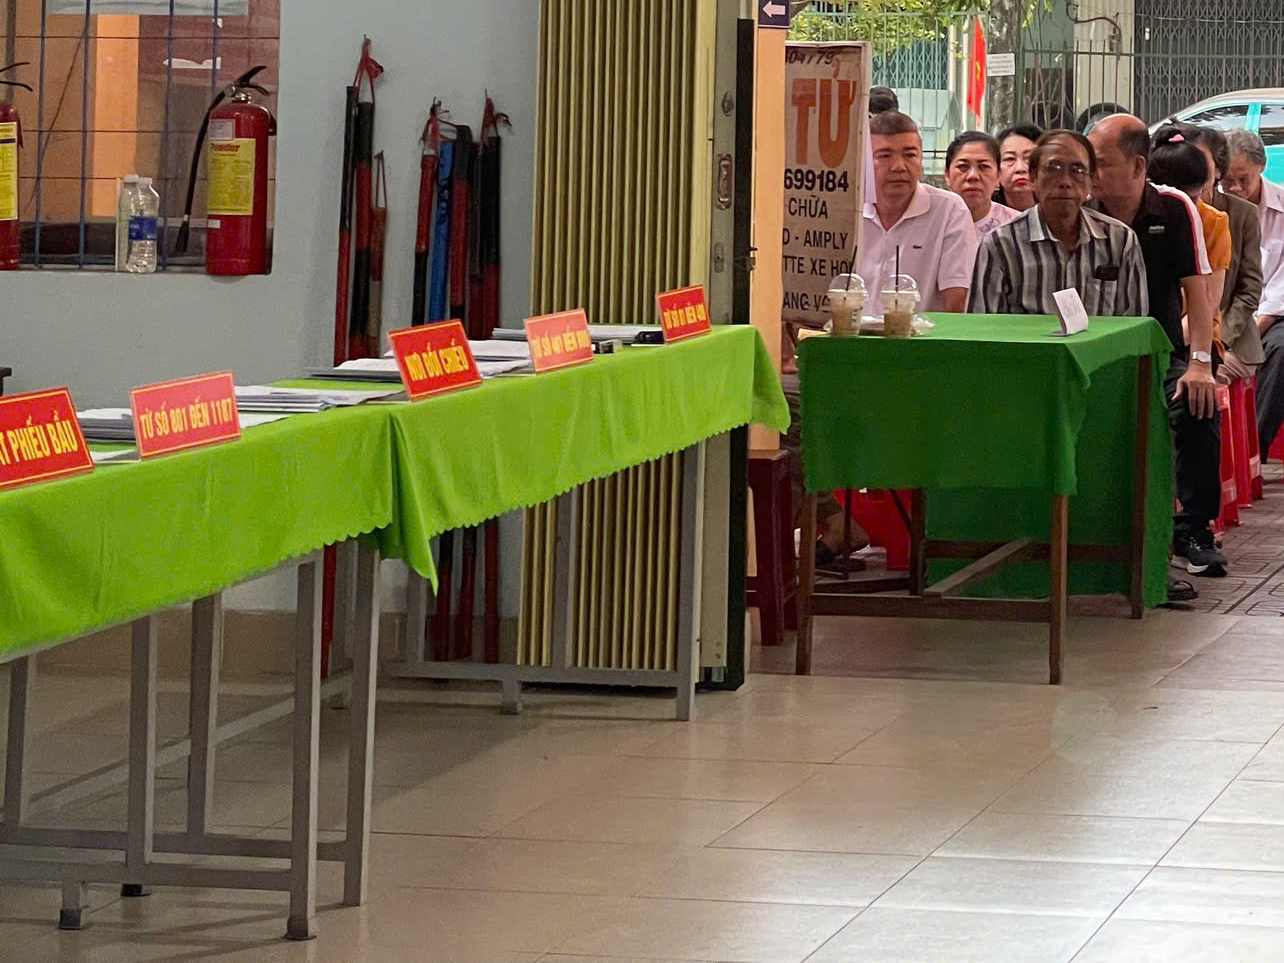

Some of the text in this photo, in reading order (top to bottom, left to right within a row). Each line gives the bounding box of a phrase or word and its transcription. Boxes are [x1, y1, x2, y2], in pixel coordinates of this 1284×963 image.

[784, 168, 849, 192] 699184
[788, 194, 828, 219] CHỮA
[803, 229, 848, 250] AMPLY
[810, 257, 827, 276] XE
[140, 408, 154, 439] TỪ
[155, 401, 170, 436] SỐ
[189, 395, 211, 430] ĐẾN
[6, 413, 51, 463] PHIẾU
[45, 410, 79, 455] BẦU
